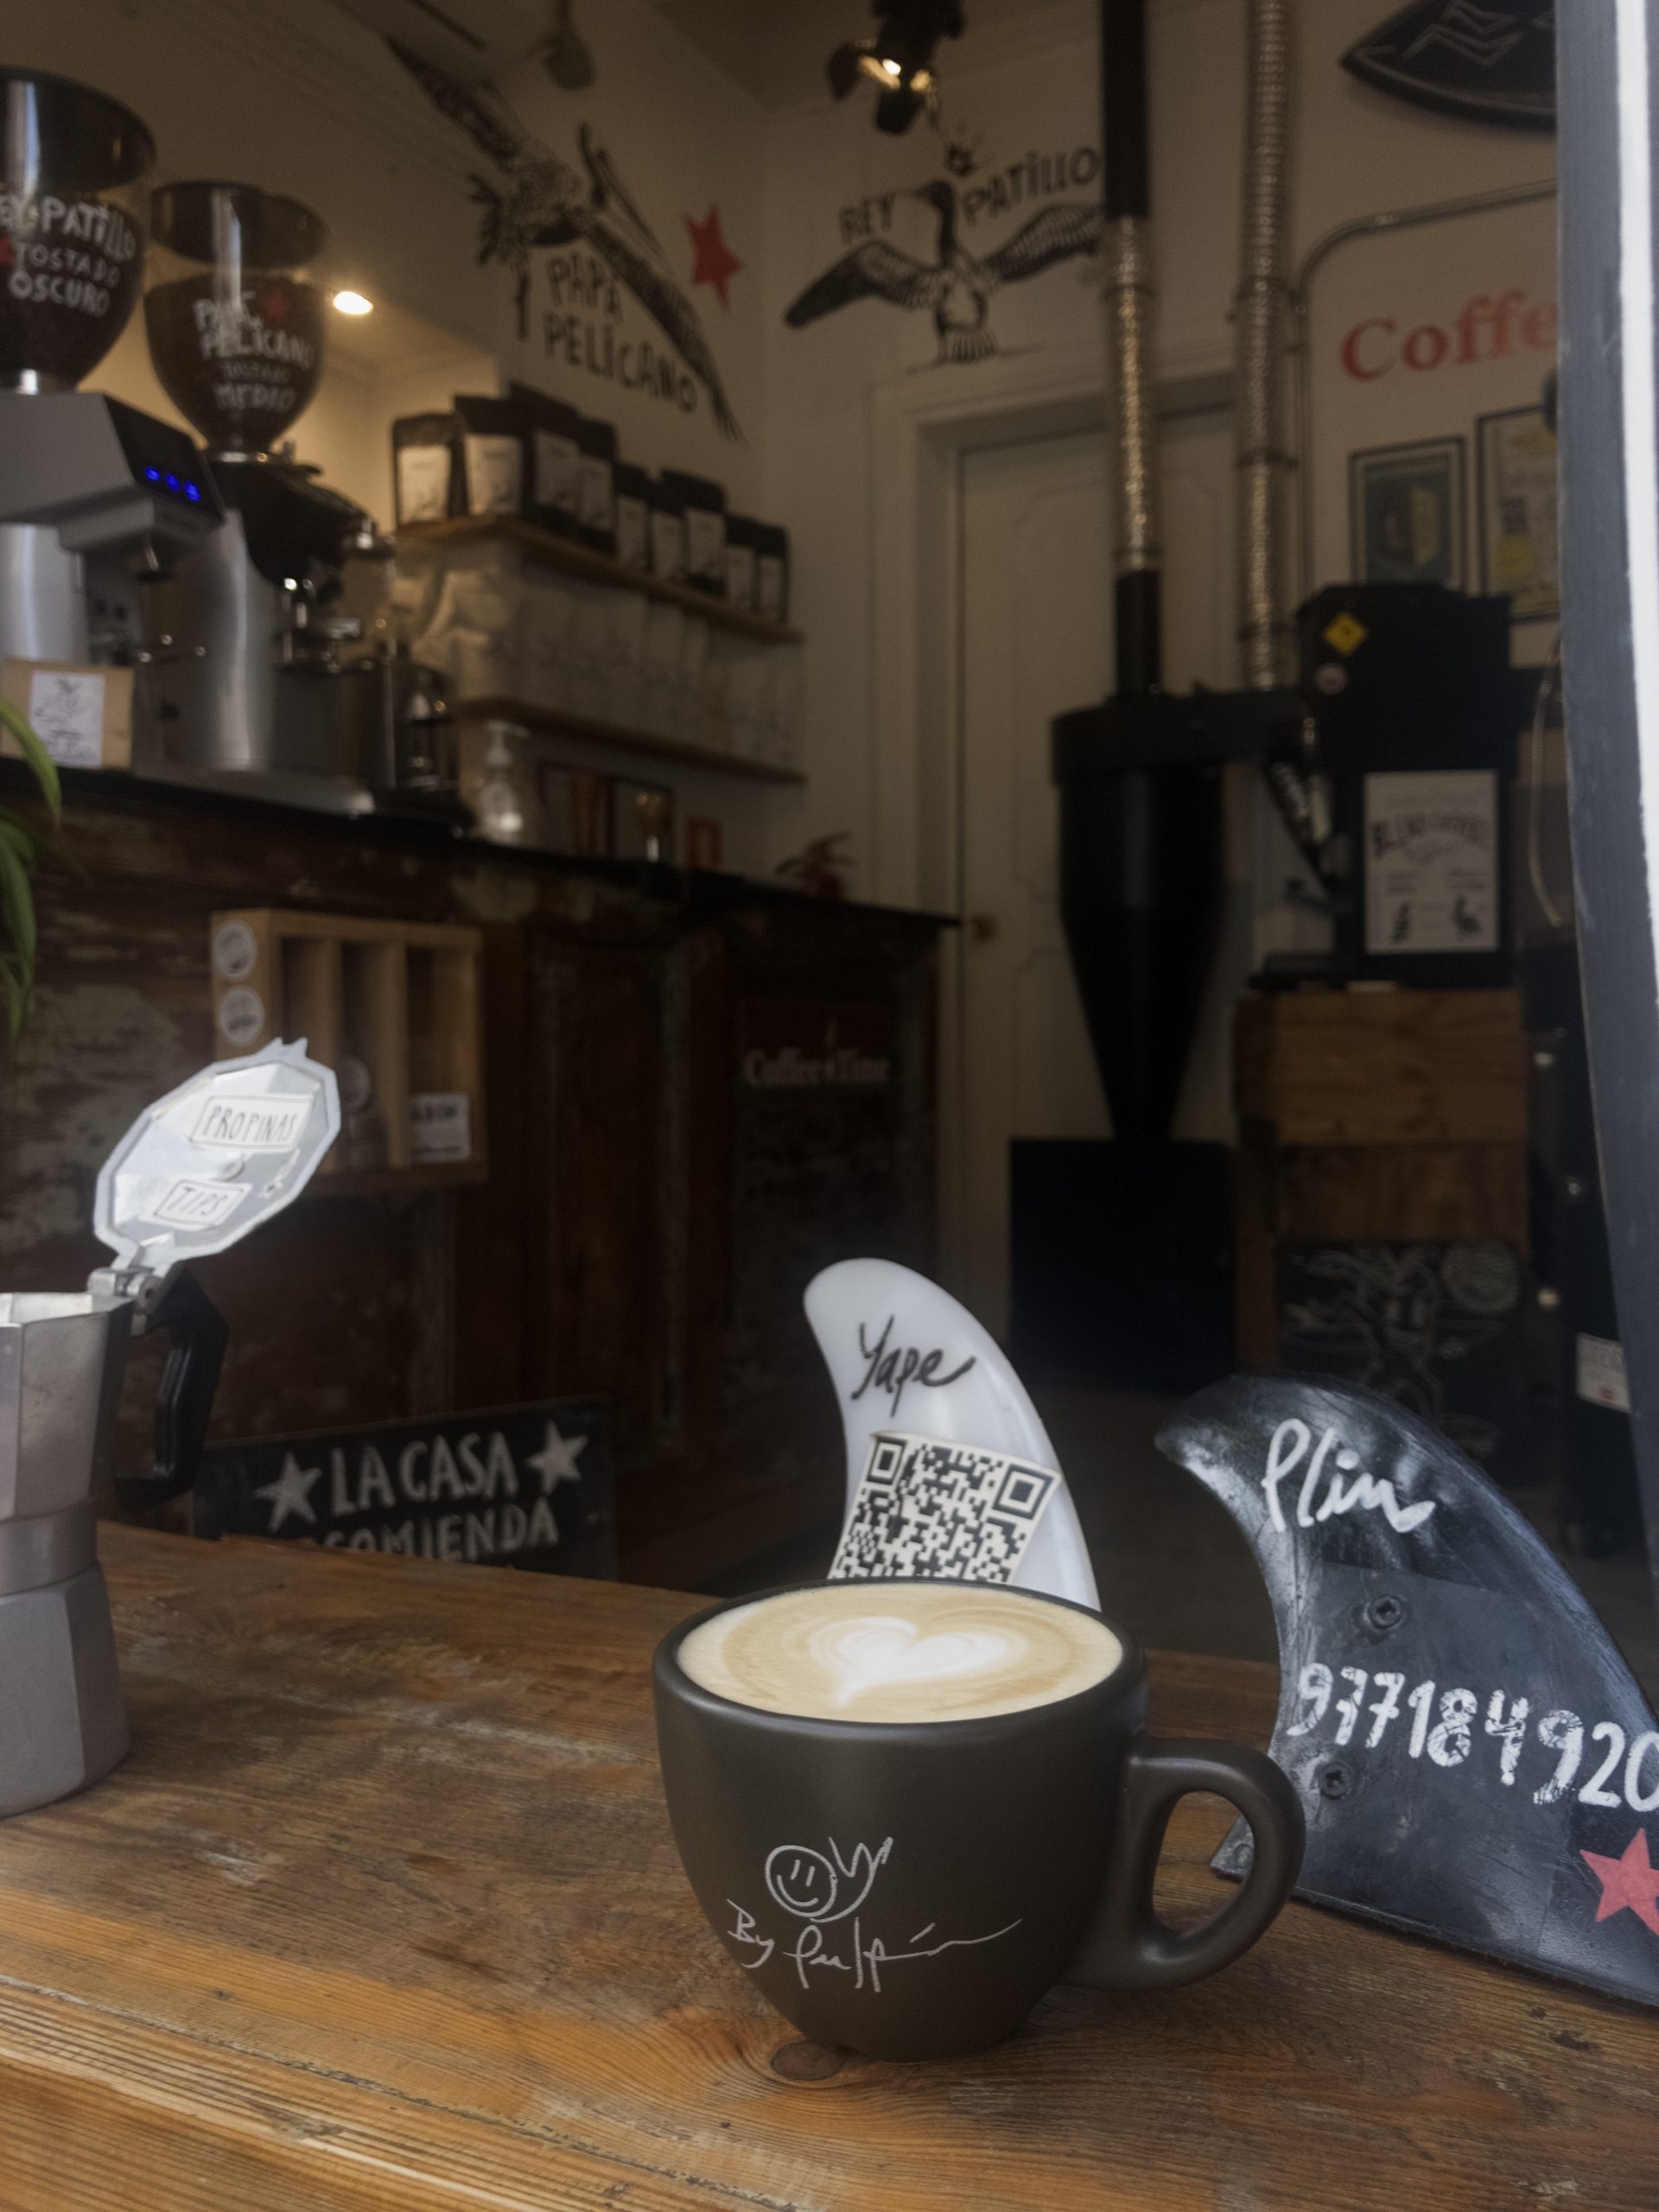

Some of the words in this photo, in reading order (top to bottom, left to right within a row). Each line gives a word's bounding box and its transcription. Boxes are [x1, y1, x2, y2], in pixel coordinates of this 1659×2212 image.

[839, 191, 896, 245] REY
[9, 270, 110, 317] OSCURO
[16, 241, 120, 288] TOSTADO
[1340, 289, 1557, 383] Coffe
[201, 1104, 298, 1142] PROPINAS
[167, 1185, 228, 1217] TIPS
[850, 1313, 976, 1418] Yape
[330, 1446, 397, 1517] LA
[398, 1431, 520, 1503] CASA
[1261, 1418, 1436, 1534] Plin
[1286, 1662, 1659, 1813] 977184920
[727, 1898, 775, 1969] By
